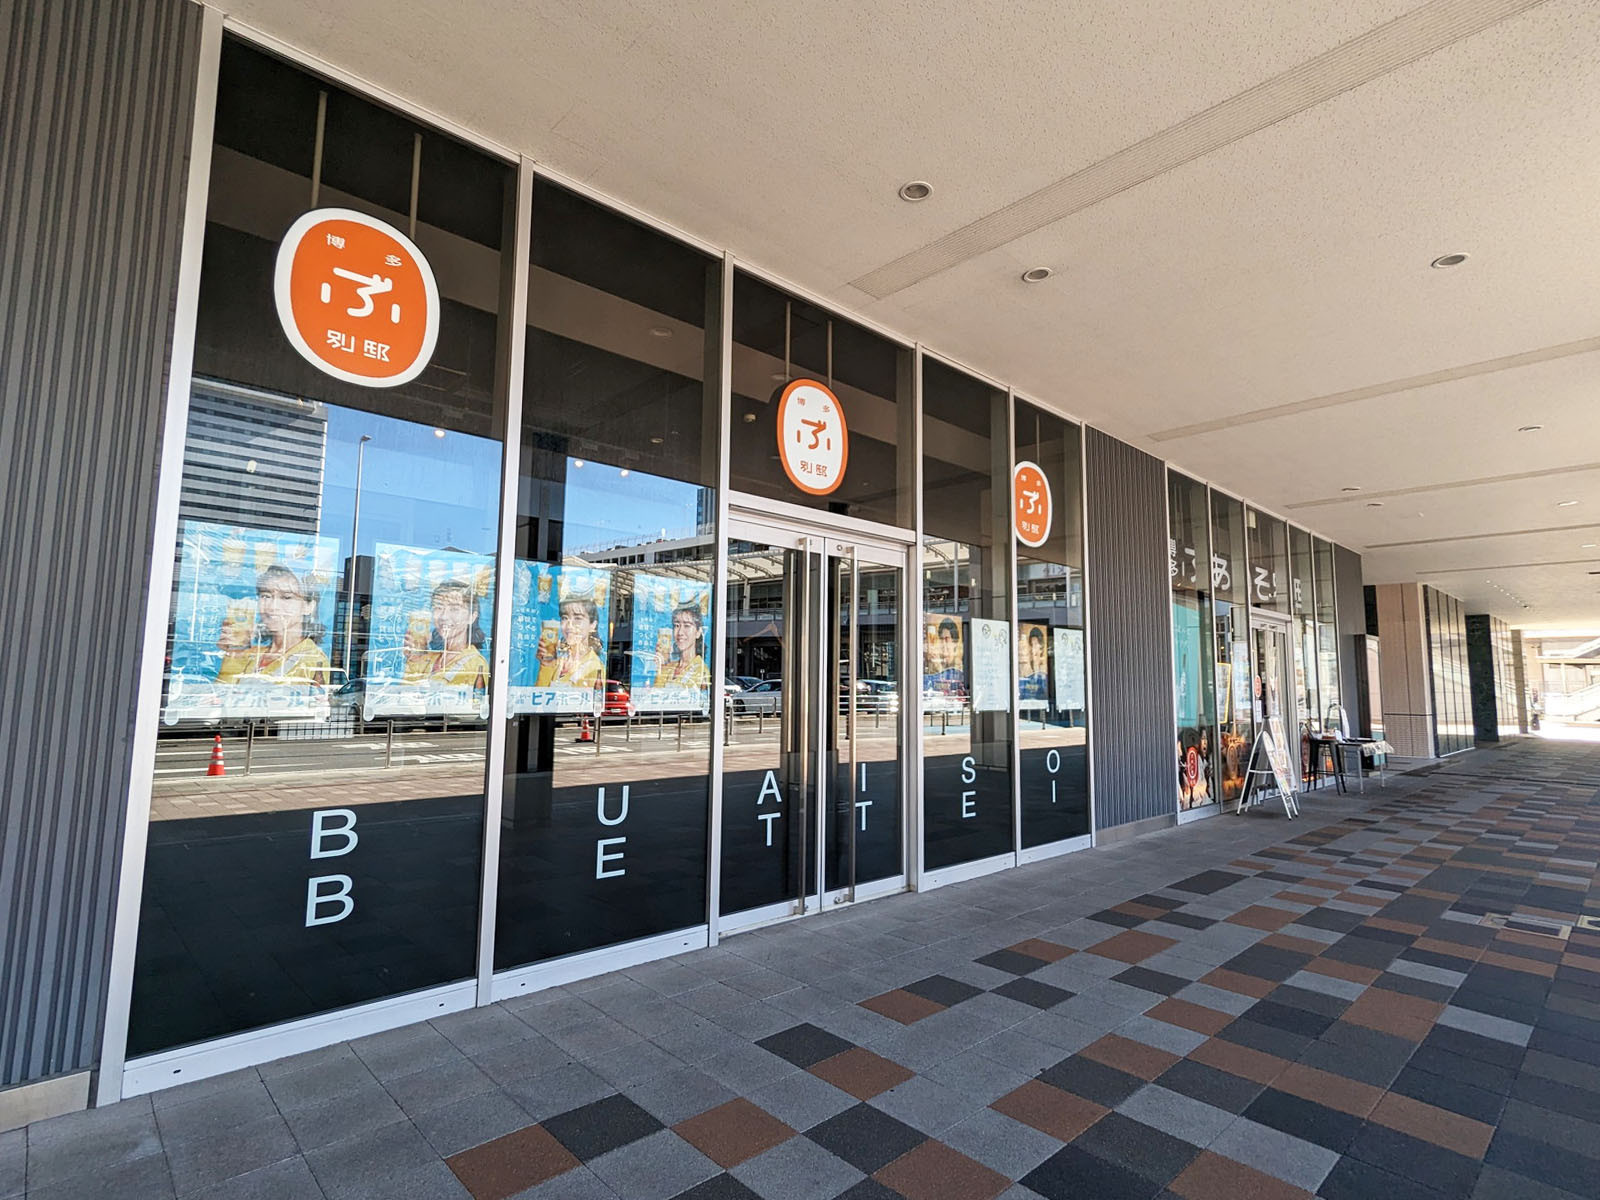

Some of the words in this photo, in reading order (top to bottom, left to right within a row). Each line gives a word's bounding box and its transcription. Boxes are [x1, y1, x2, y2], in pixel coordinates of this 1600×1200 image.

[320, 267, 401, 324] ぶ
[326, 330, 390, 362] 別邸
[796, 418, 831, 451] ぶ
